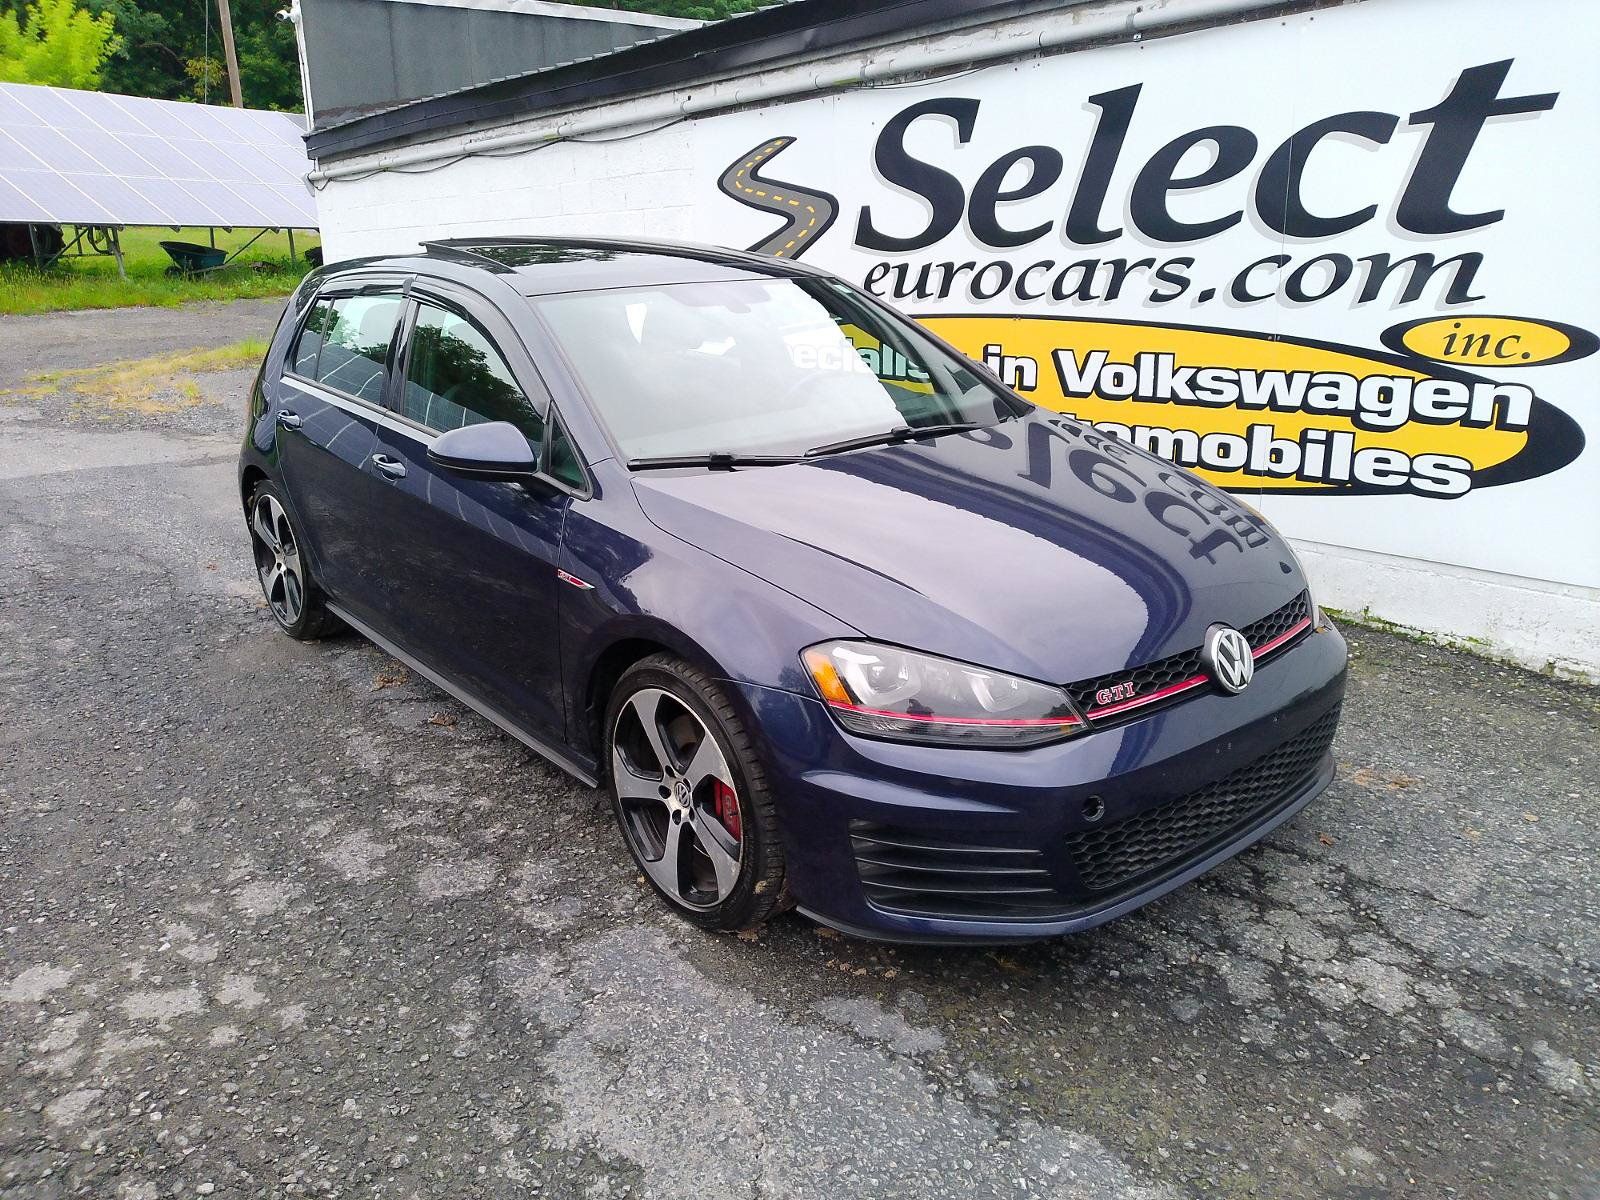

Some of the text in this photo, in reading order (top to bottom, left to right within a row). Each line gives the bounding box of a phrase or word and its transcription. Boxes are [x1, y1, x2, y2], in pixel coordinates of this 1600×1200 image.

[854, 57, 1560, 252] Select
[863, 252, 1486, 305] eurocars.com
[1443, 322, 1530, 360] inc.
[984, 344, 1038, 391] in
[1054, 348, 1534, 430] Volkswagen
[1096, 681, 1137, 705] GTI
